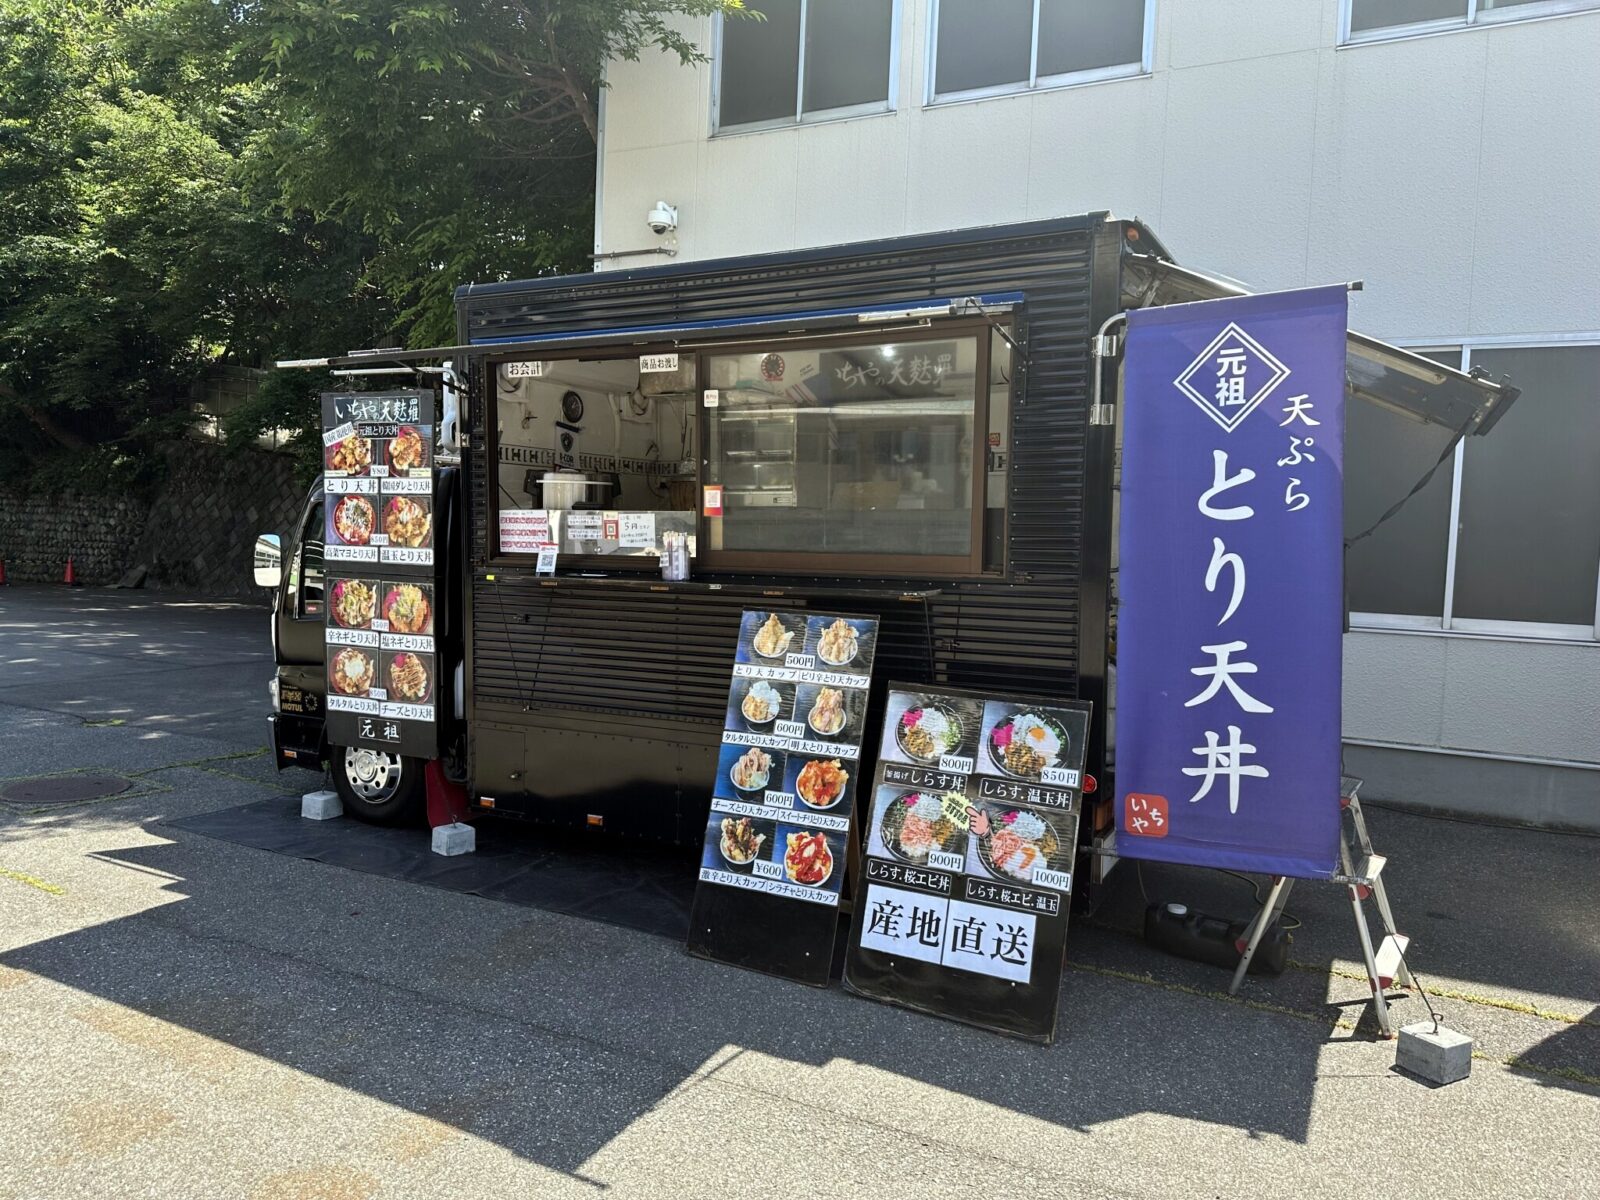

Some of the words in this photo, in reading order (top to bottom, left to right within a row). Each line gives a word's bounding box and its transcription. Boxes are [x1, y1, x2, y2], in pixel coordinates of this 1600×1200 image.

[509, 362, 541, 376] お会計
[641, 356, 678, 370] 商品お渡し
[1215, 348, 1247, 407] 元祖
[359, 425, 398, 437] 元祖とり天丼
[1278, 393, 1321, 513] 天ぷら
[326, 480, 376, 492] とり天丼
[325, 547, 376, 560] 高菜マヨとり天丼
[382, 549, 433, 563] 温玉とり天丼
[327, 631, 378, 645] 辛ネギとり天丼
[1181, 449, 1275, 815] とり天丼
[382, 635, 433, 650] 塩ネギとり天丼
[786, 655, 815, 668] 500円
[735, 667, 798, 680] とり天カップ
[282, 702, 303, 712] MOTUL
[328, 697, 378, 712] タルタルとり天丼
[382, 704, 432, 719] チーズとり天丼
[361, 719, 400, 740] 元祖
[776, 723, 804, 735] 600円
[724, 732, 788, 748] タルタルとり天カップ
[790, 740, 858, 756] 明太とり天カップ
[941, 757, 972, 772] 800円
[1042, 769, 1078, 784] 850円
[766, 793, 793, 807] 600円
[713, 801, 778, 818] チーズとり天カップ
[780, 811, 848, 828] スイートチリとり天カップ
[755, 862, 782, 877] ¥600
[930, 854, 961, 870] 900円
[701, 870, 768, 889] 激辛とり天カップ
[1035, 870, 1069, 888] 1000円
[768, 883, 838, 903] シラチャとり天カップ
[867, 899, 1028, 967] 産地直送
